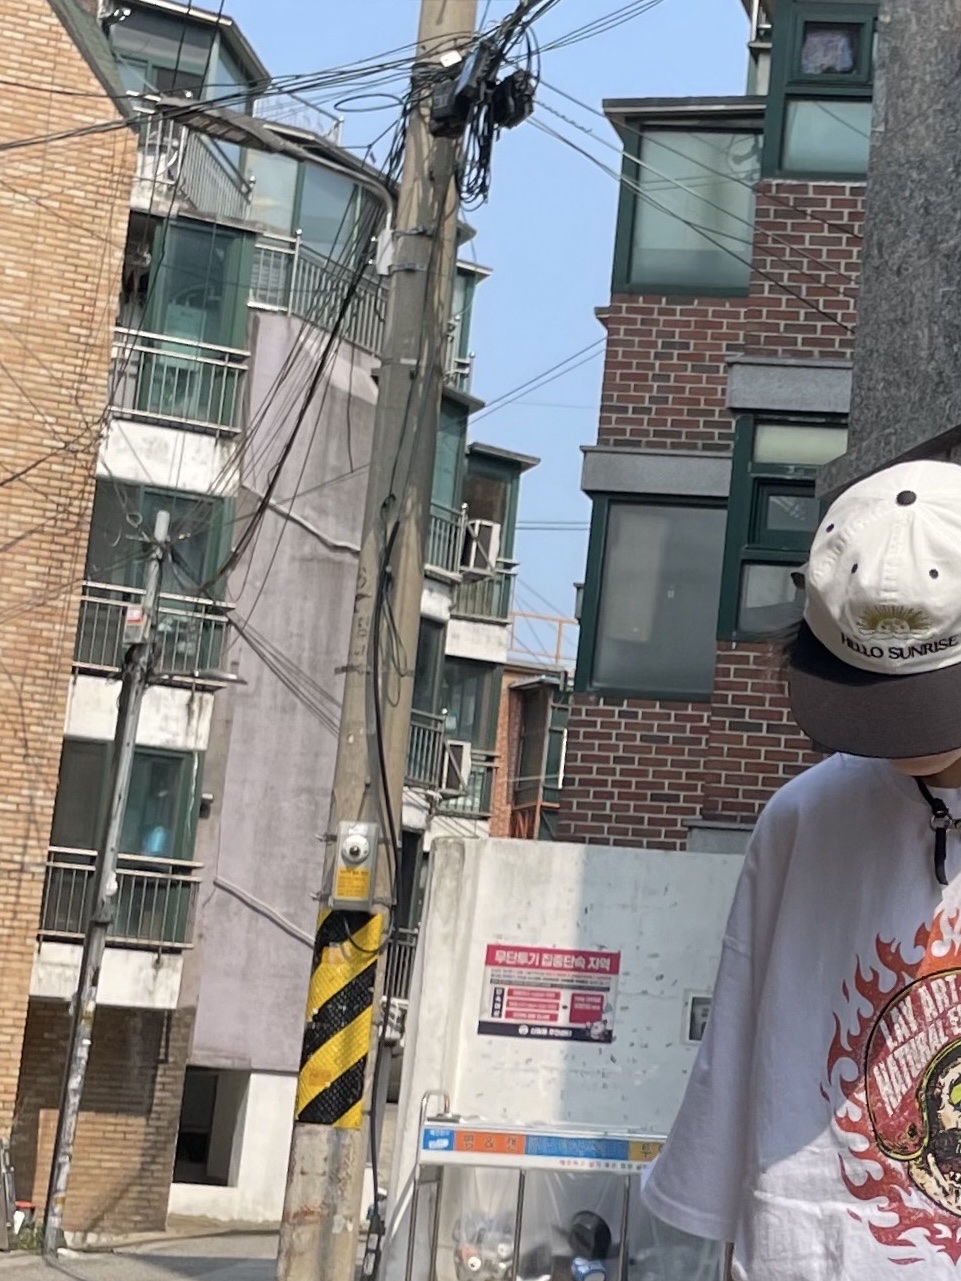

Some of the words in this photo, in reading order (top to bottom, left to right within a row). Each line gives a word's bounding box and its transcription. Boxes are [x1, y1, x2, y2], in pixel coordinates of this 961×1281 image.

[841, 632, 884, 658] HELLO
[888, 635, 959, 659] SUNRISE
[494, 949, 540, 966] 무단투기
[917, 975, 960, 1023] ART
